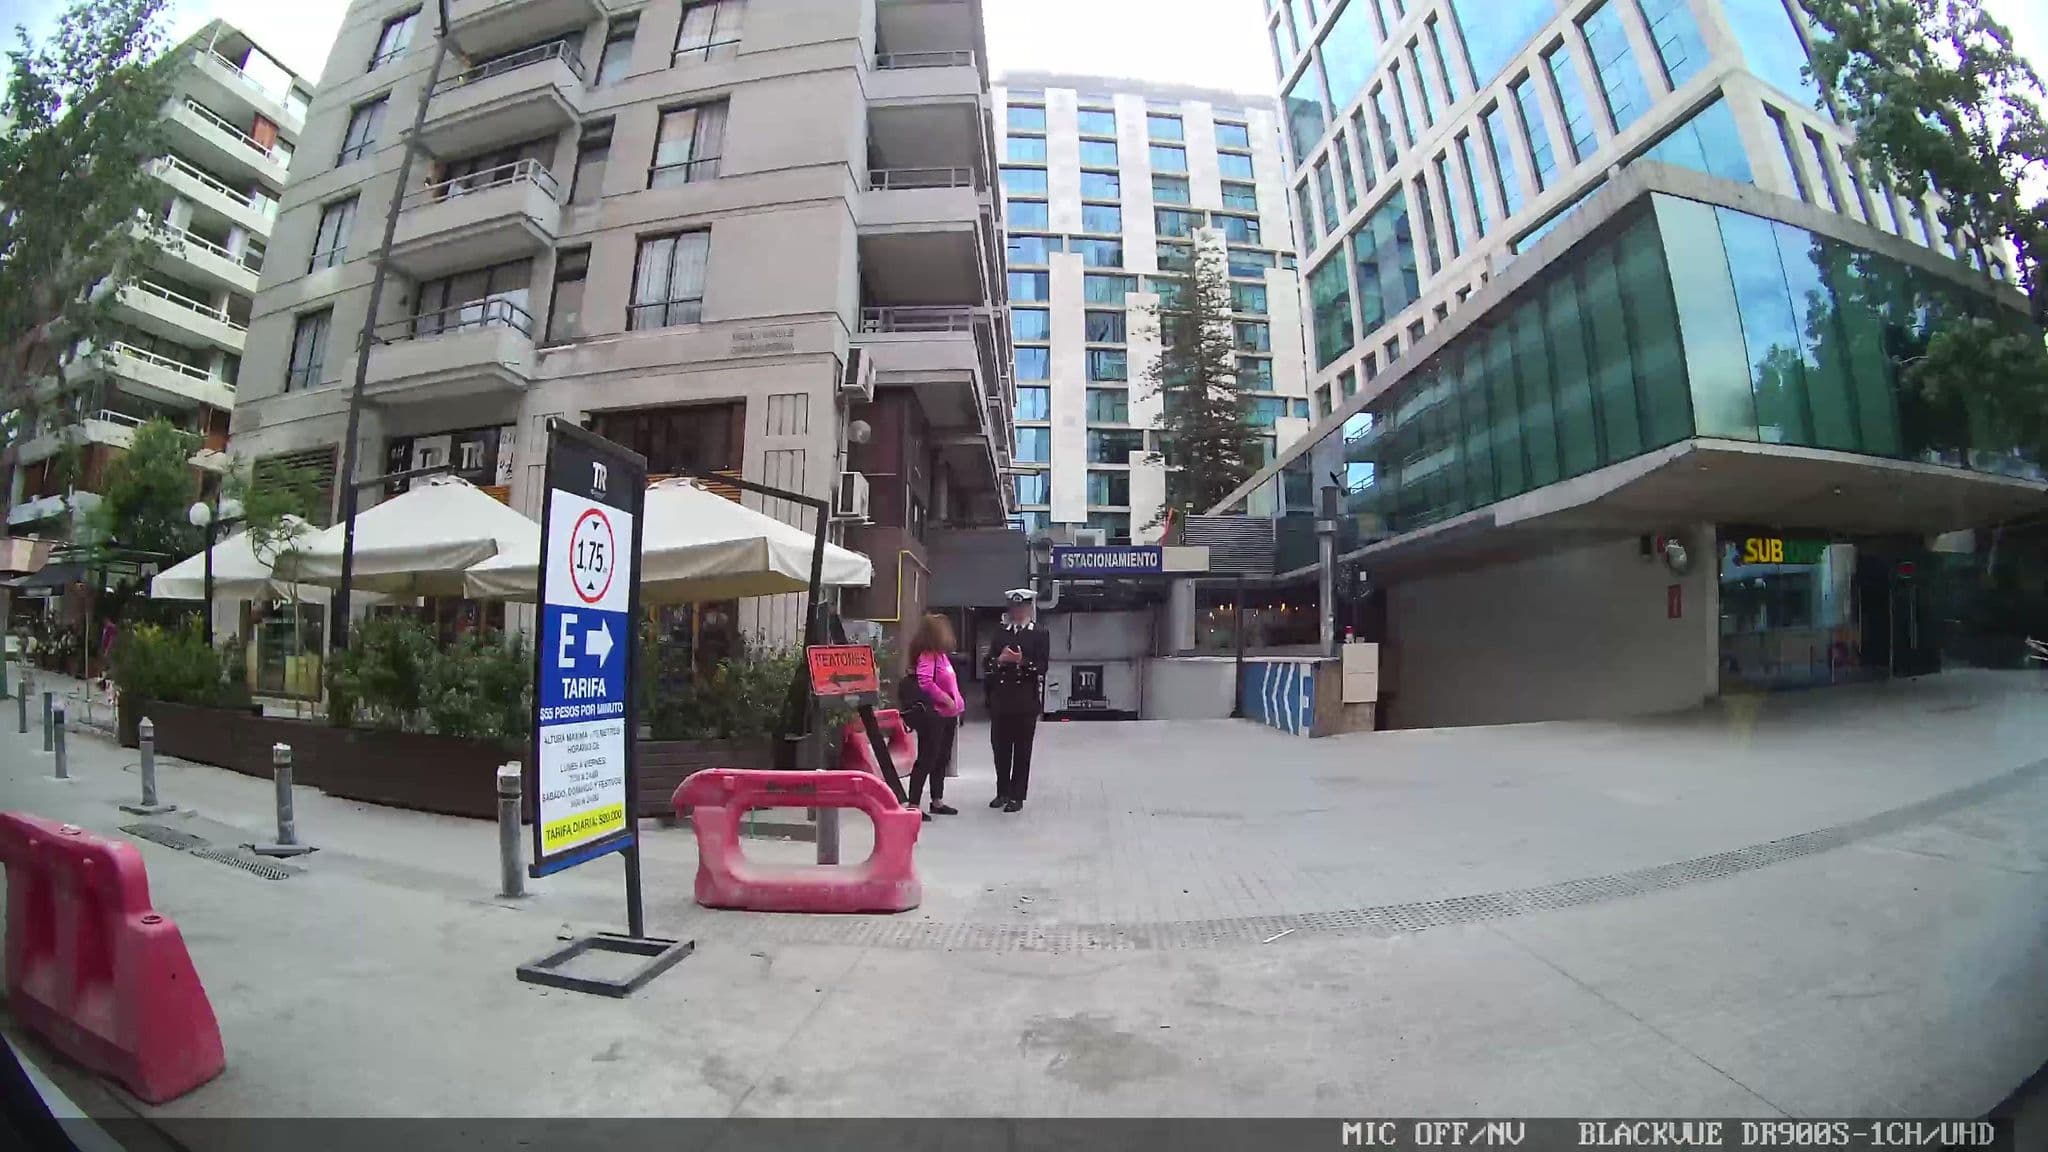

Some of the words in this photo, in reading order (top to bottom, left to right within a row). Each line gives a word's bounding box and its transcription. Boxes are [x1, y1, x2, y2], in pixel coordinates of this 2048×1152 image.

[1061, 552, 1158, 569] ESTACIONAMIENTO
[558, 613, 578, 668] E
[562, 677, 606, 699] TARIFA
[554, 705, 580, 720] PESOS
[545, 823, 573, 842] TARIFA
